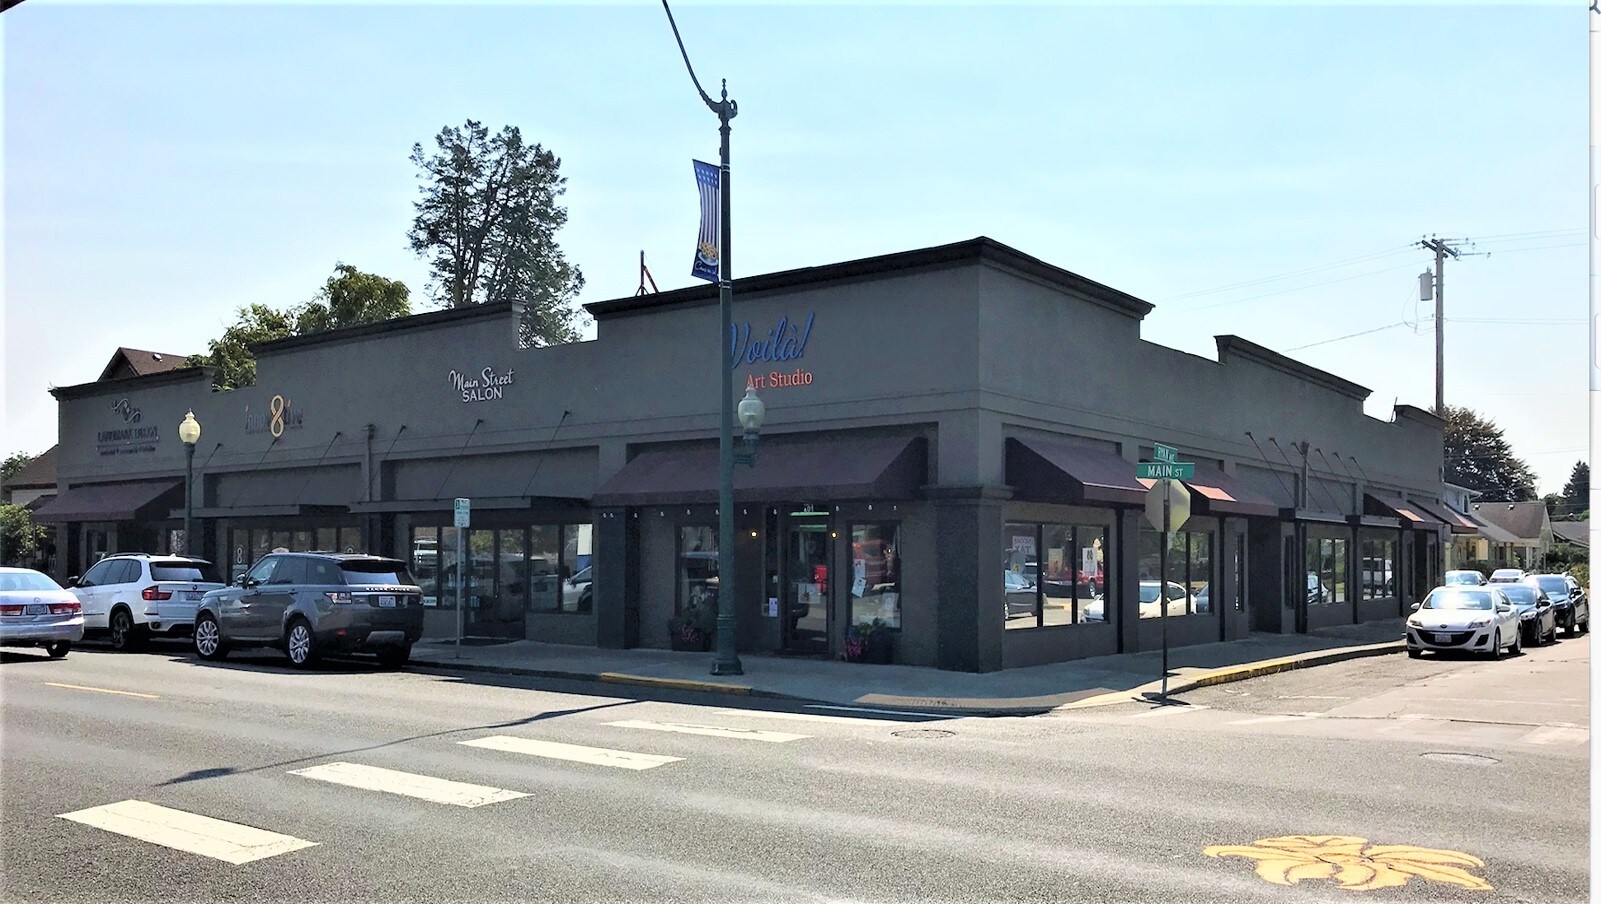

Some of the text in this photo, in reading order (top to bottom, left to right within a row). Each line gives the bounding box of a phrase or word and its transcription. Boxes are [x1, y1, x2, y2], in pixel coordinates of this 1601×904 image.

[448, 366, 515, 392] Main Street
[745, 368, 813, 391] Art Studio
[462, 387, 503, 403] SALON
[1157, 446, 1170, 461] RYAN
[1147, 465, 1184, 477] MAIN ST
